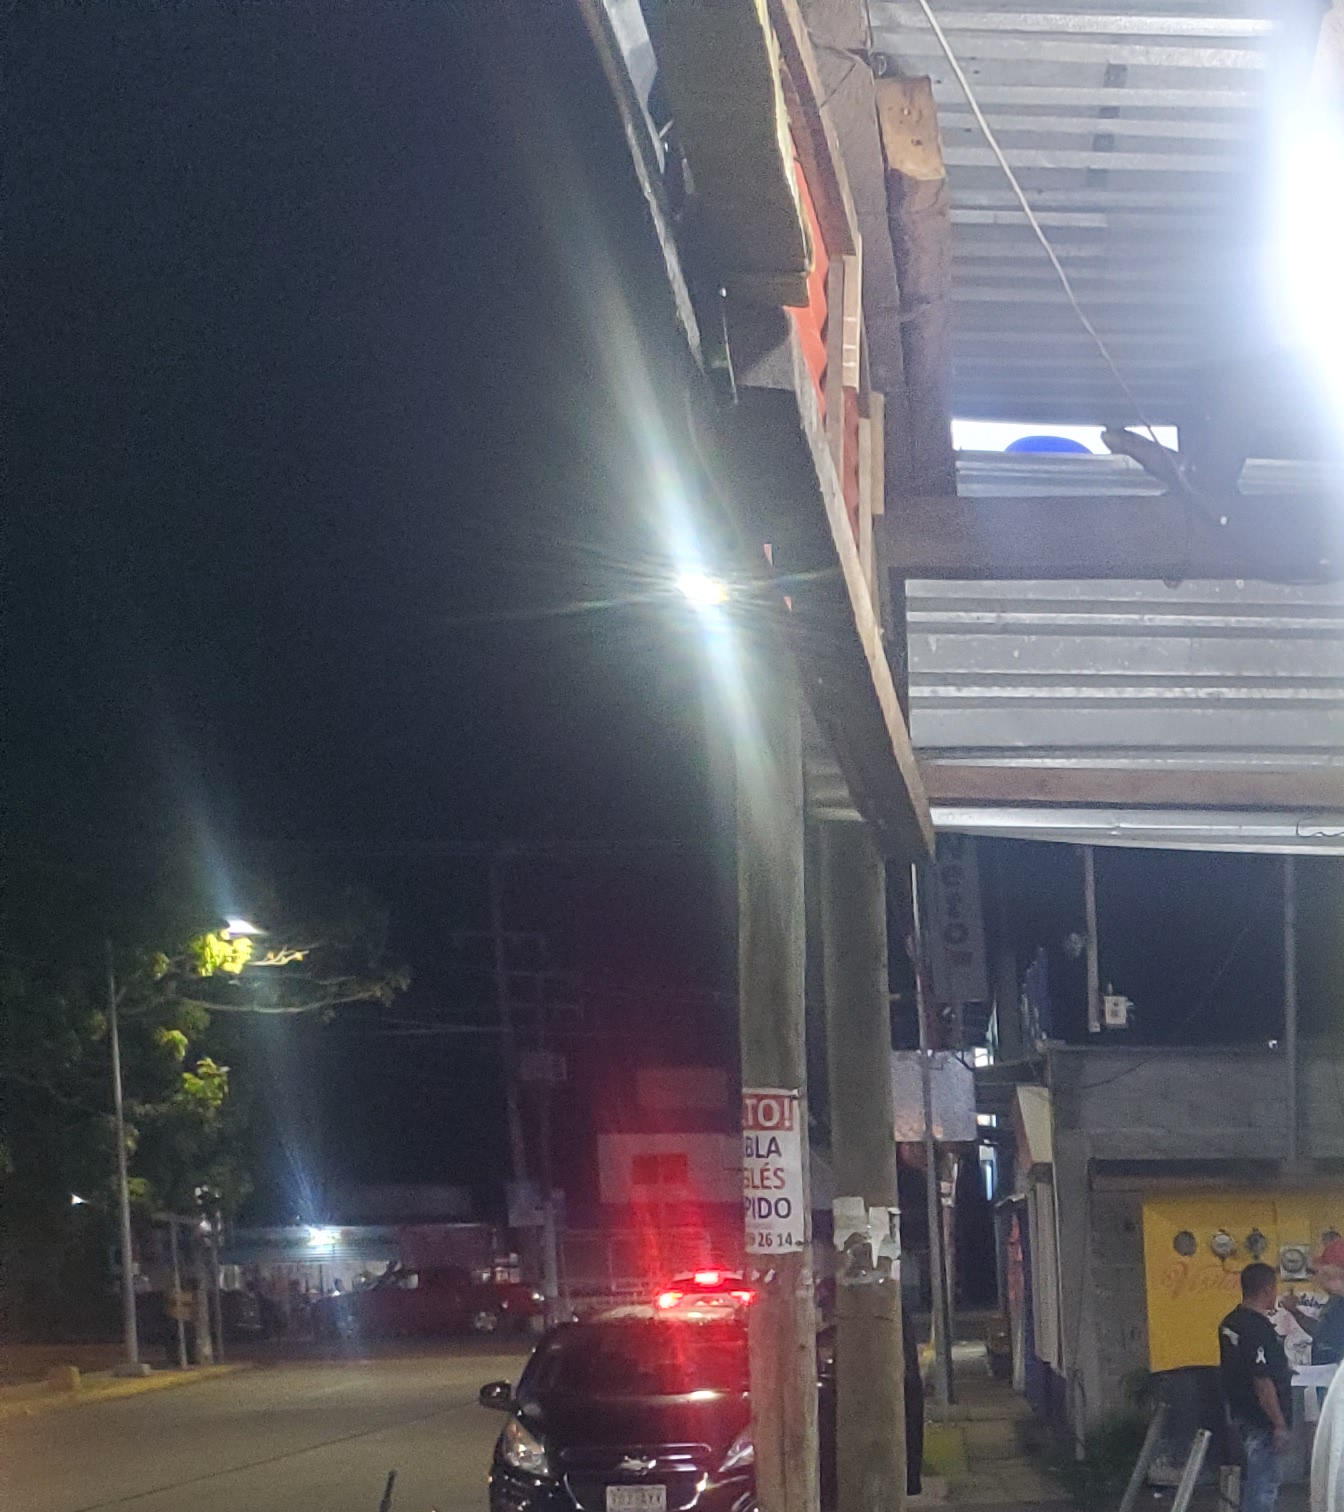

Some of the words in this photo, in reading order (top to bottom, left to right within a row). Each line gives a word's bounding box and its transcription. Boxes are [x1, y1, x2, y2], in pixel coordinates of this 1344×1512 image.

[743, 1098, 792, 1127] TO!
[758, 1231, 773, 1247] 26
[777, 1231, 793, 1247] 14
